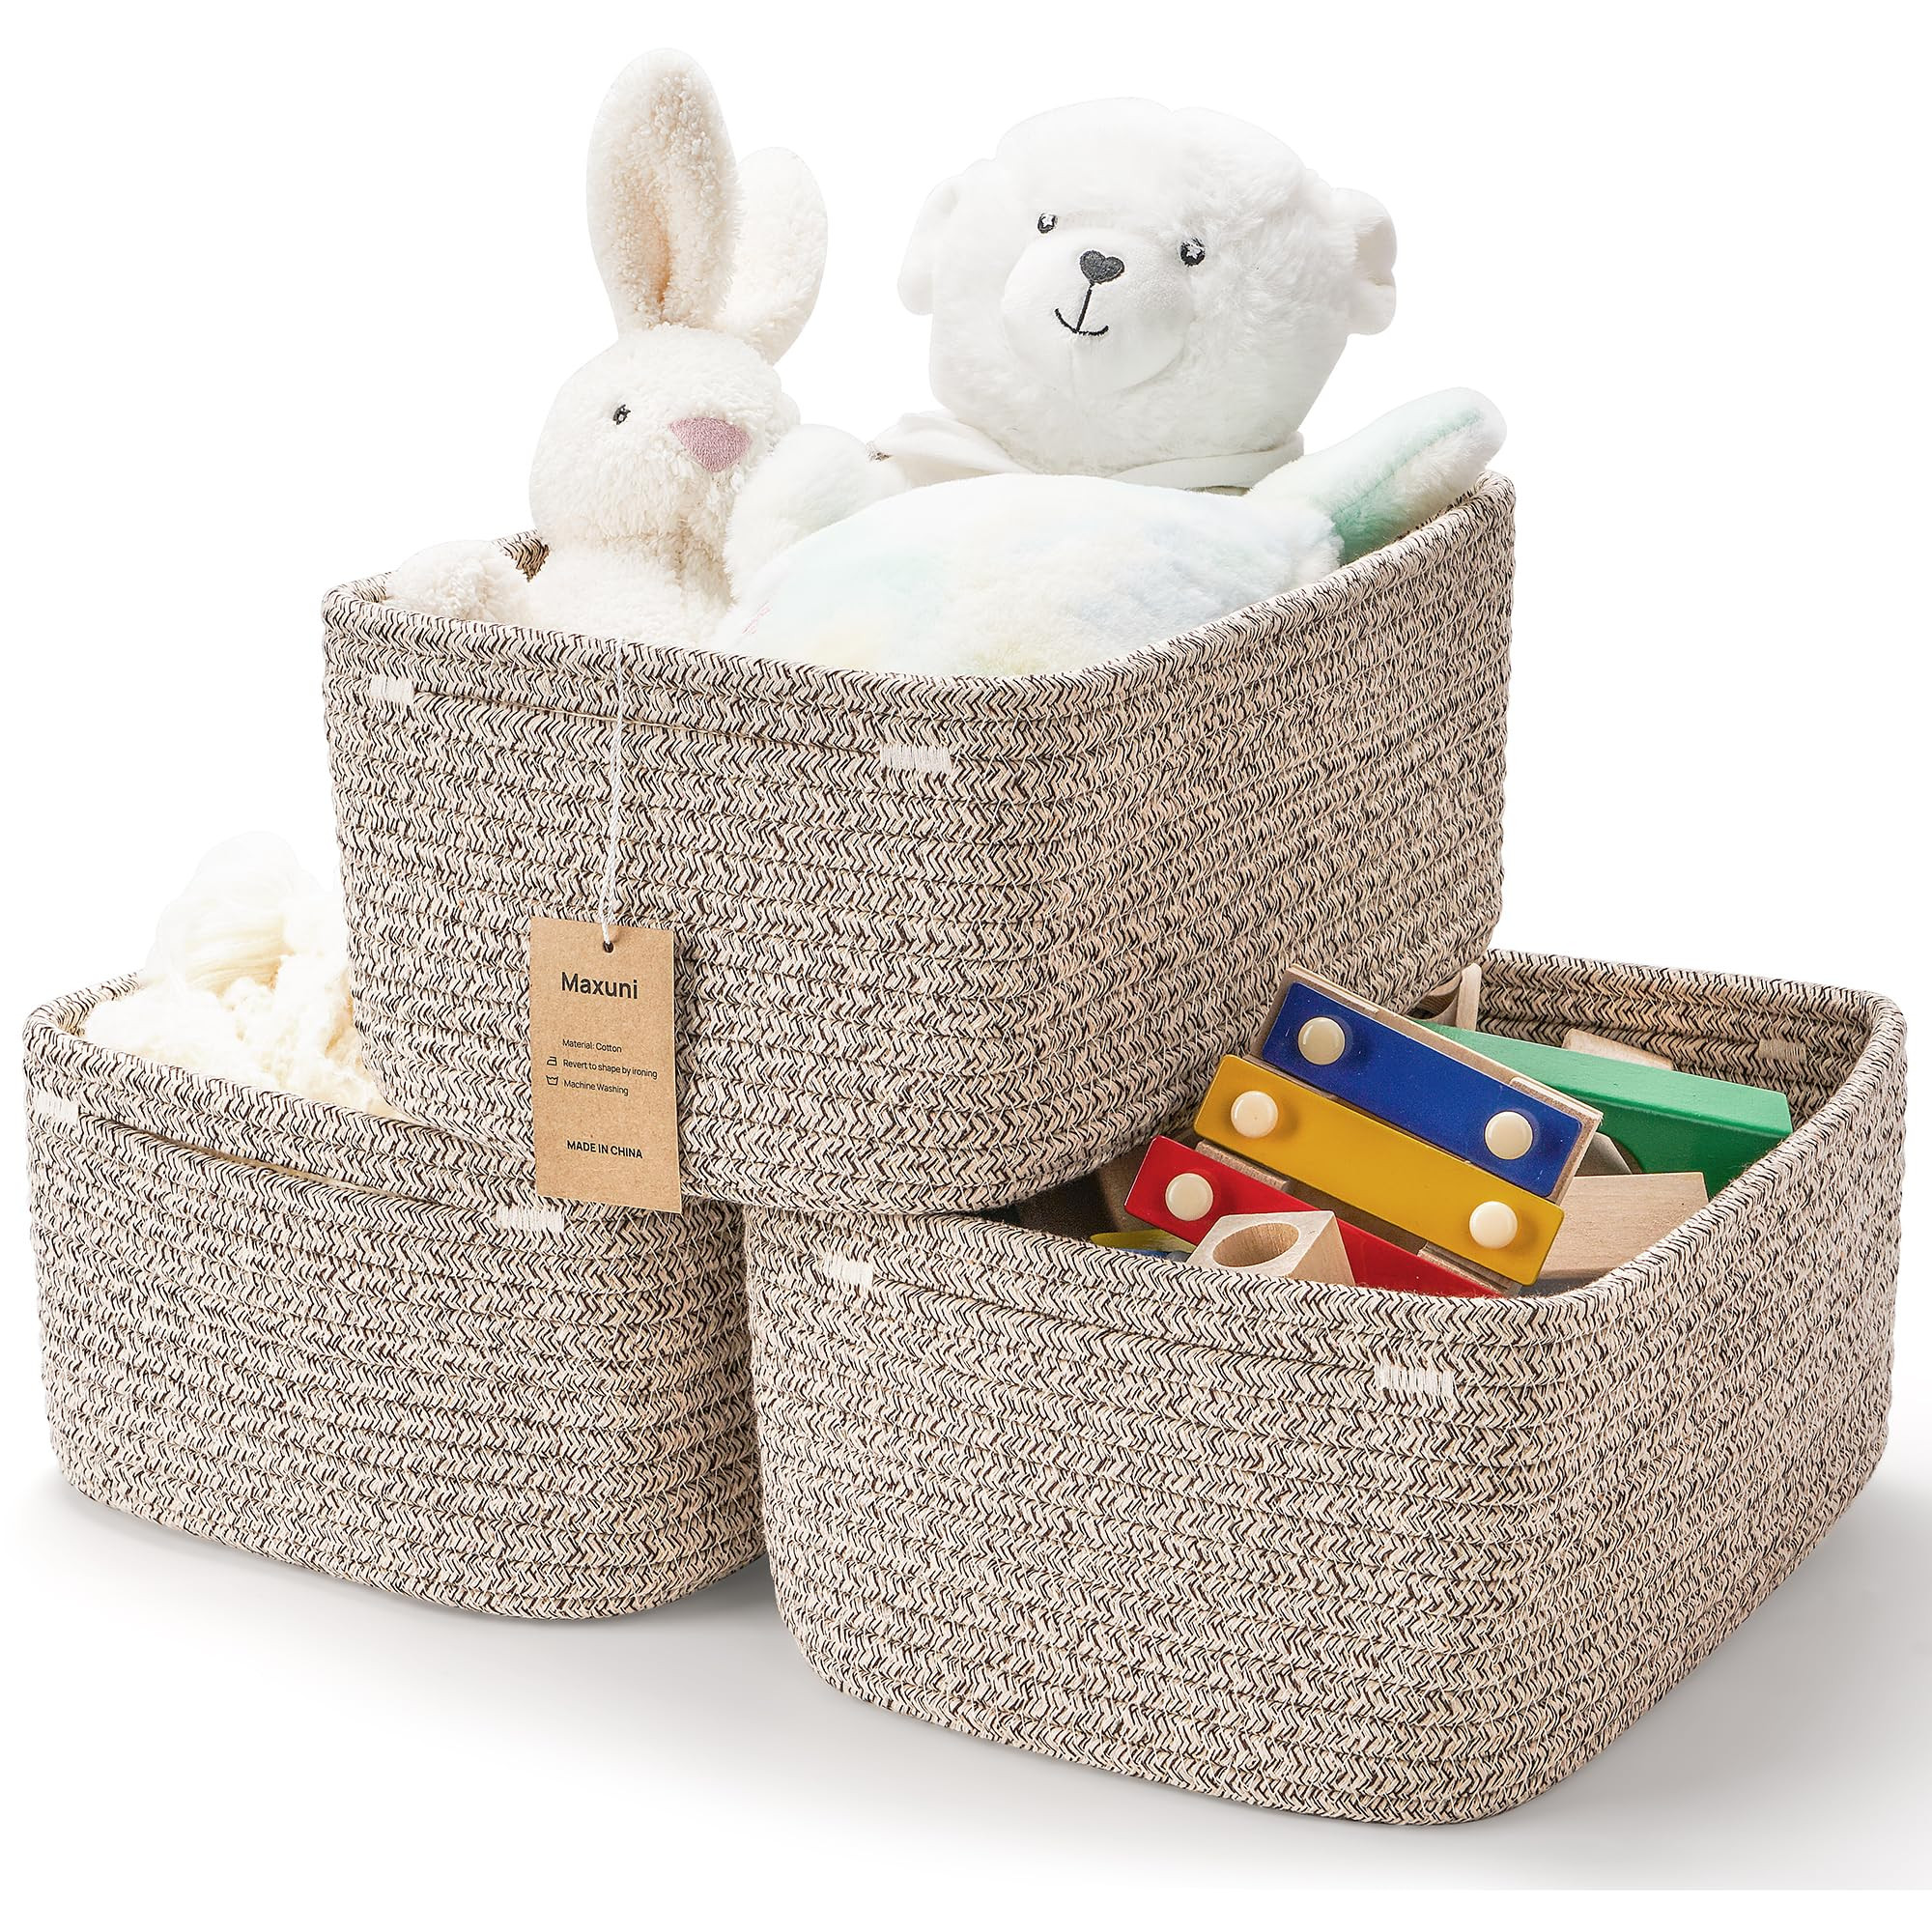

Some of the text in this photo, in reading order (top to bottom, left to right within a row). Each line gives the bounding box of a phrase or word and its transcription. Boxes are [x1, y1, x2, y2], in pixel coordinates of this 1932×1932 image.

[561, 972, 639, 999] Maxuni
[562, 1038, 622, 1053] Material: Cotton
[563, 1059, 588, 1069] Revert
[598, 1065, 621, 1074] shape
[622, 1066, 632, 1076] by
[633, 1068, 658, 1079] ironing
[564, 1080, 629, 1096] Machine Washing
[567, 1140, 642, 1158] MADE IN CHINA
